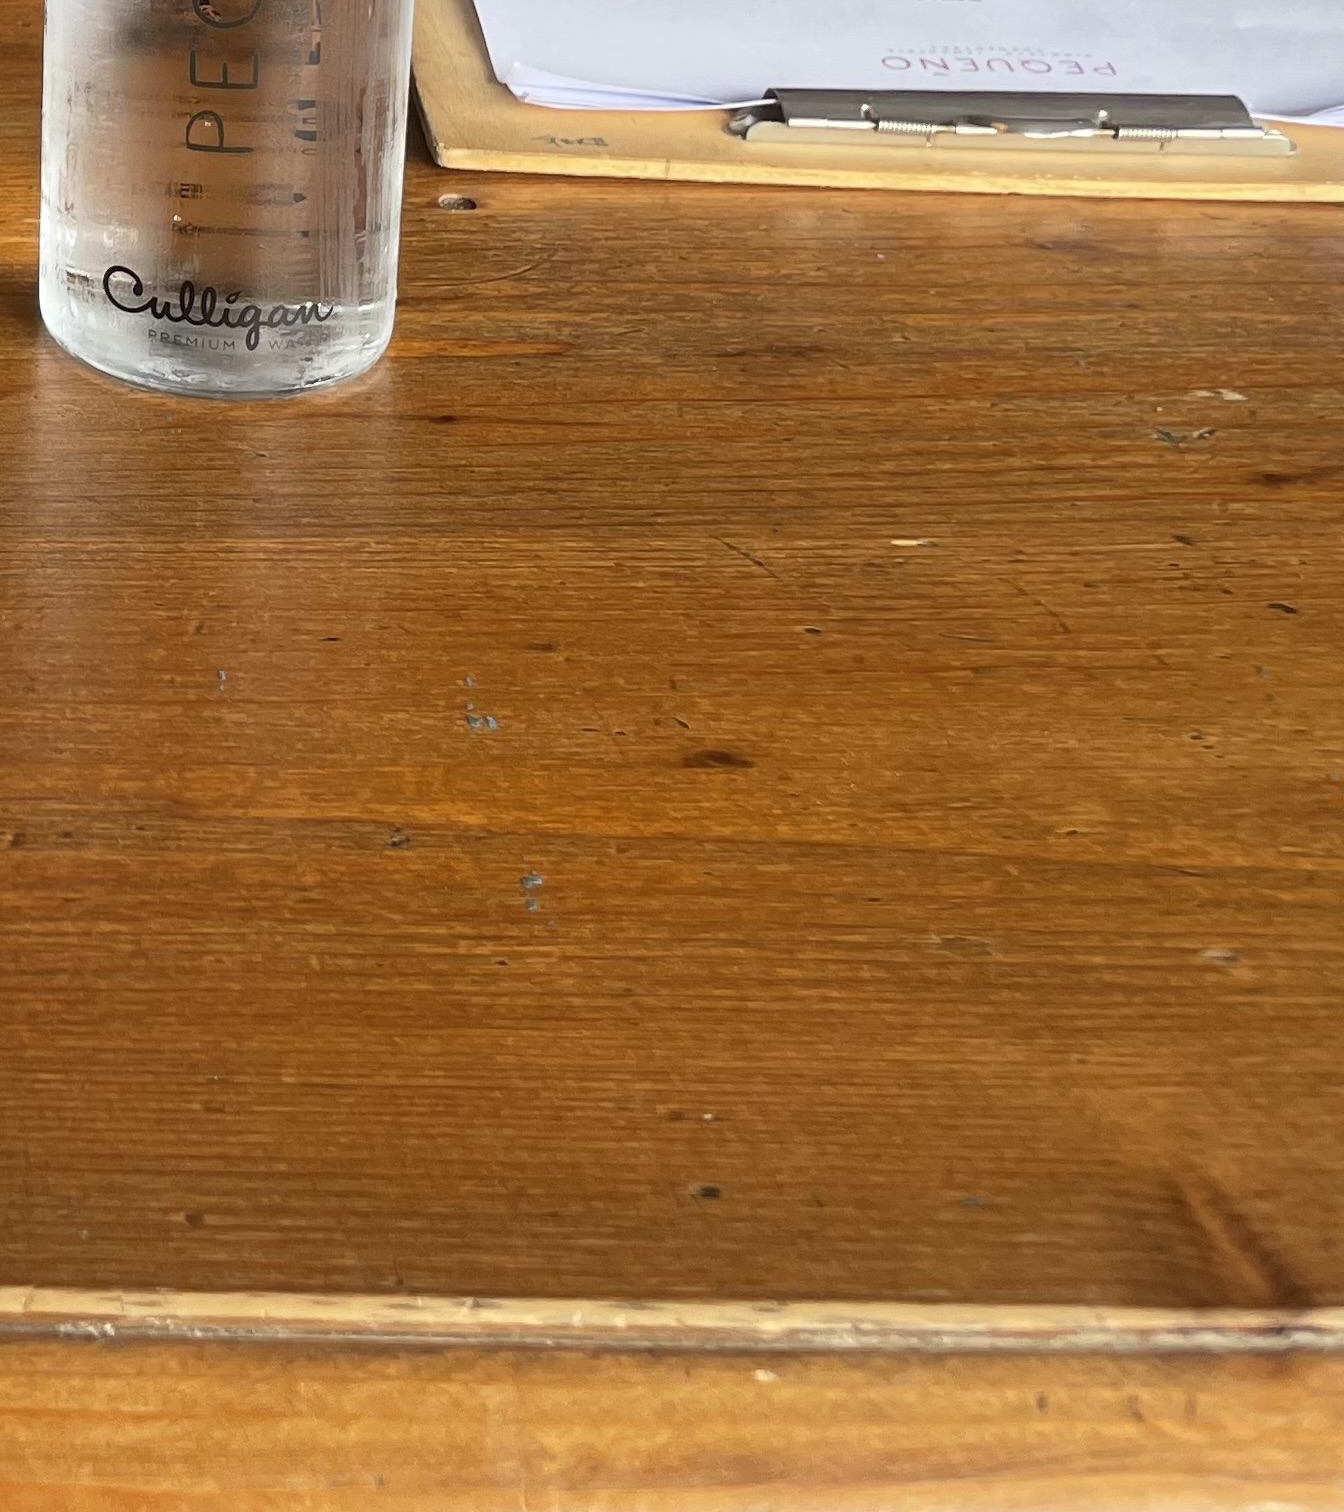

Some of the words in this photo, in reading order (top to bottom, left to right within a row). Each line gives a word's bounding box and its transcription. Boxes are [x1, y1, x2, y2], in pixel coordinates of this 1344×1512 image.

[881, 55, 1118, 78] PEQUEÑO
[102, 264, 334, 351] Culligan
[147, 328, 236, 351] PREMIUM
[267, 331, 332, 351] WAR
